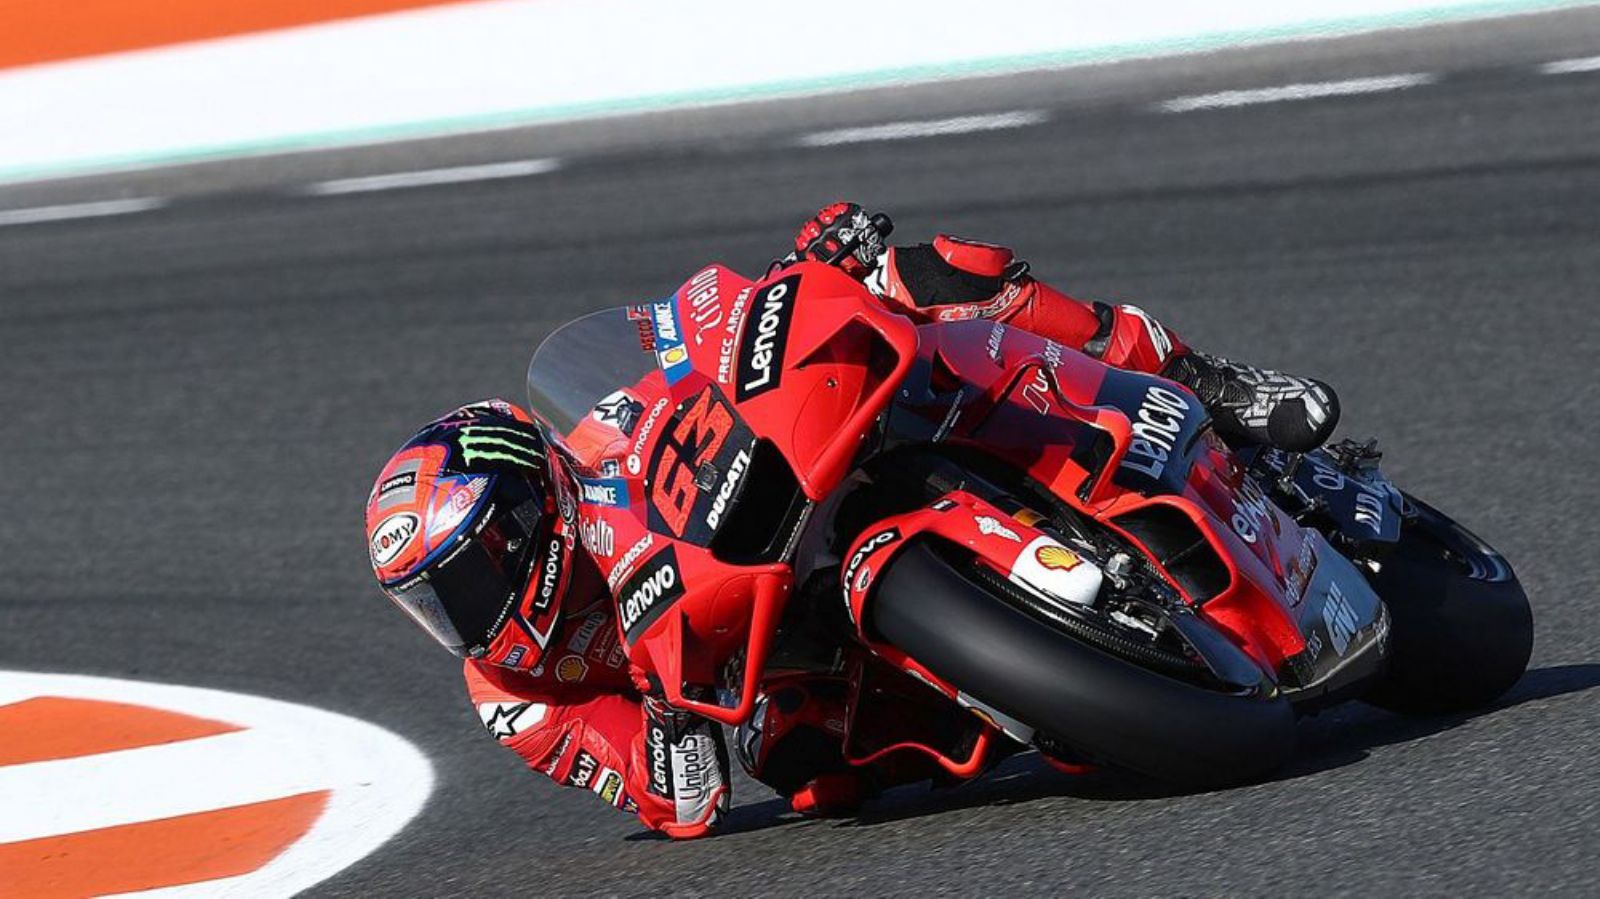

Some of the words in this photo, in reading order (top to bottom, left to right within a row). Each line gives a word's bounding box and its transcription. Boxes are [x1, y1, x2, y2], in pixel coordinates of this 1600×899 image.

[744, 283, 788, 392] Lenovo
[634, 397, 669, 455] motorola
[652, 385, 734, 538] 63
[706, 449, 751, 531] DUCATI
[535, 540, 561, 609] Lenovo
[618, 564, 676, 632] Lenovo
[648, 727, 668, 794] Lenovo
